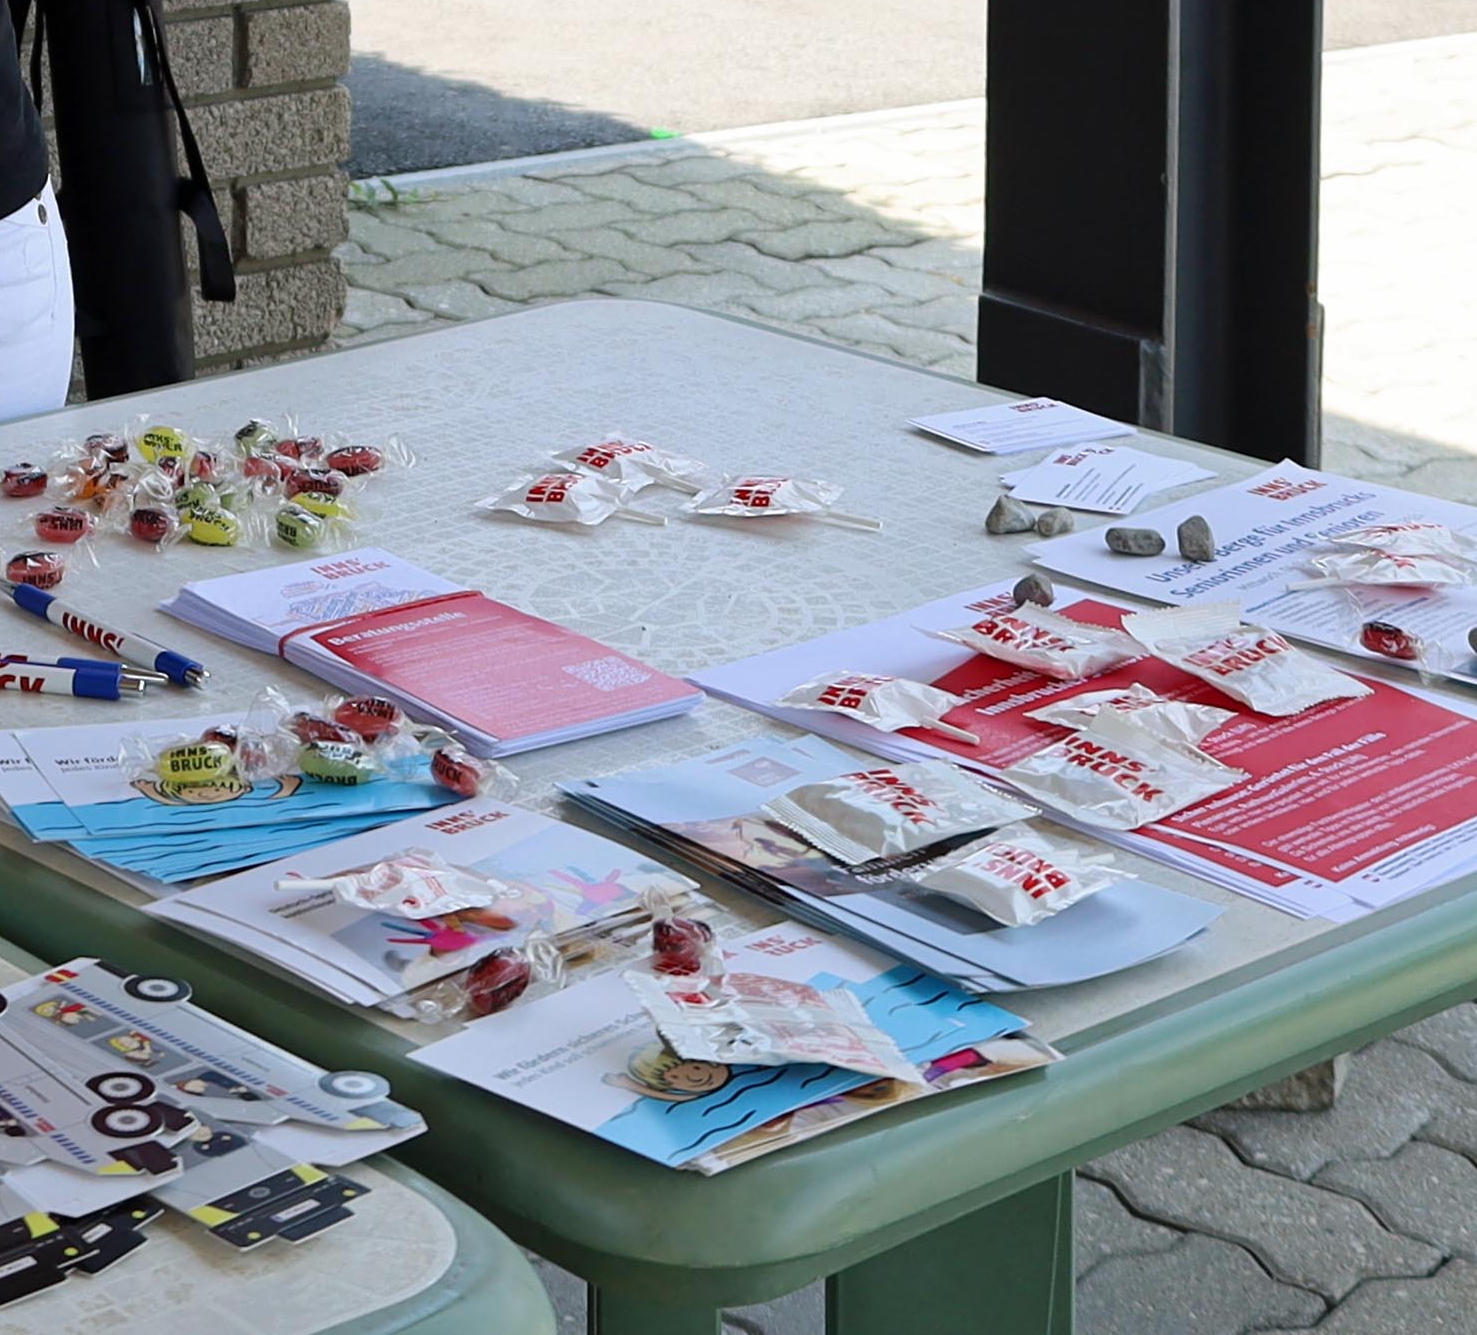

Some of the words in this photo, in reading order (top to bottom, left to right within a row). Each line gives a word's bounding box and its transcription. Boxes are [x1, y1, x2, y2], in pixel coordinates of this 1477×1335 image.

[1278, 479, 1328, 502] BRUCK
[1258, 519, 1285, 544] für
[1283, 490, 1376, 532] Innsbrucks
[322, 560, 390, 581] BRUCK
[1169, 549, 1279, 599] Seniorinnen
[1274, 535, 1318, 561] und
[327, 610, 467, 649] Beratungsstelle
[170, 755, 224, 772] BRUCK
[445, 811, 509, 836] BRUCK
